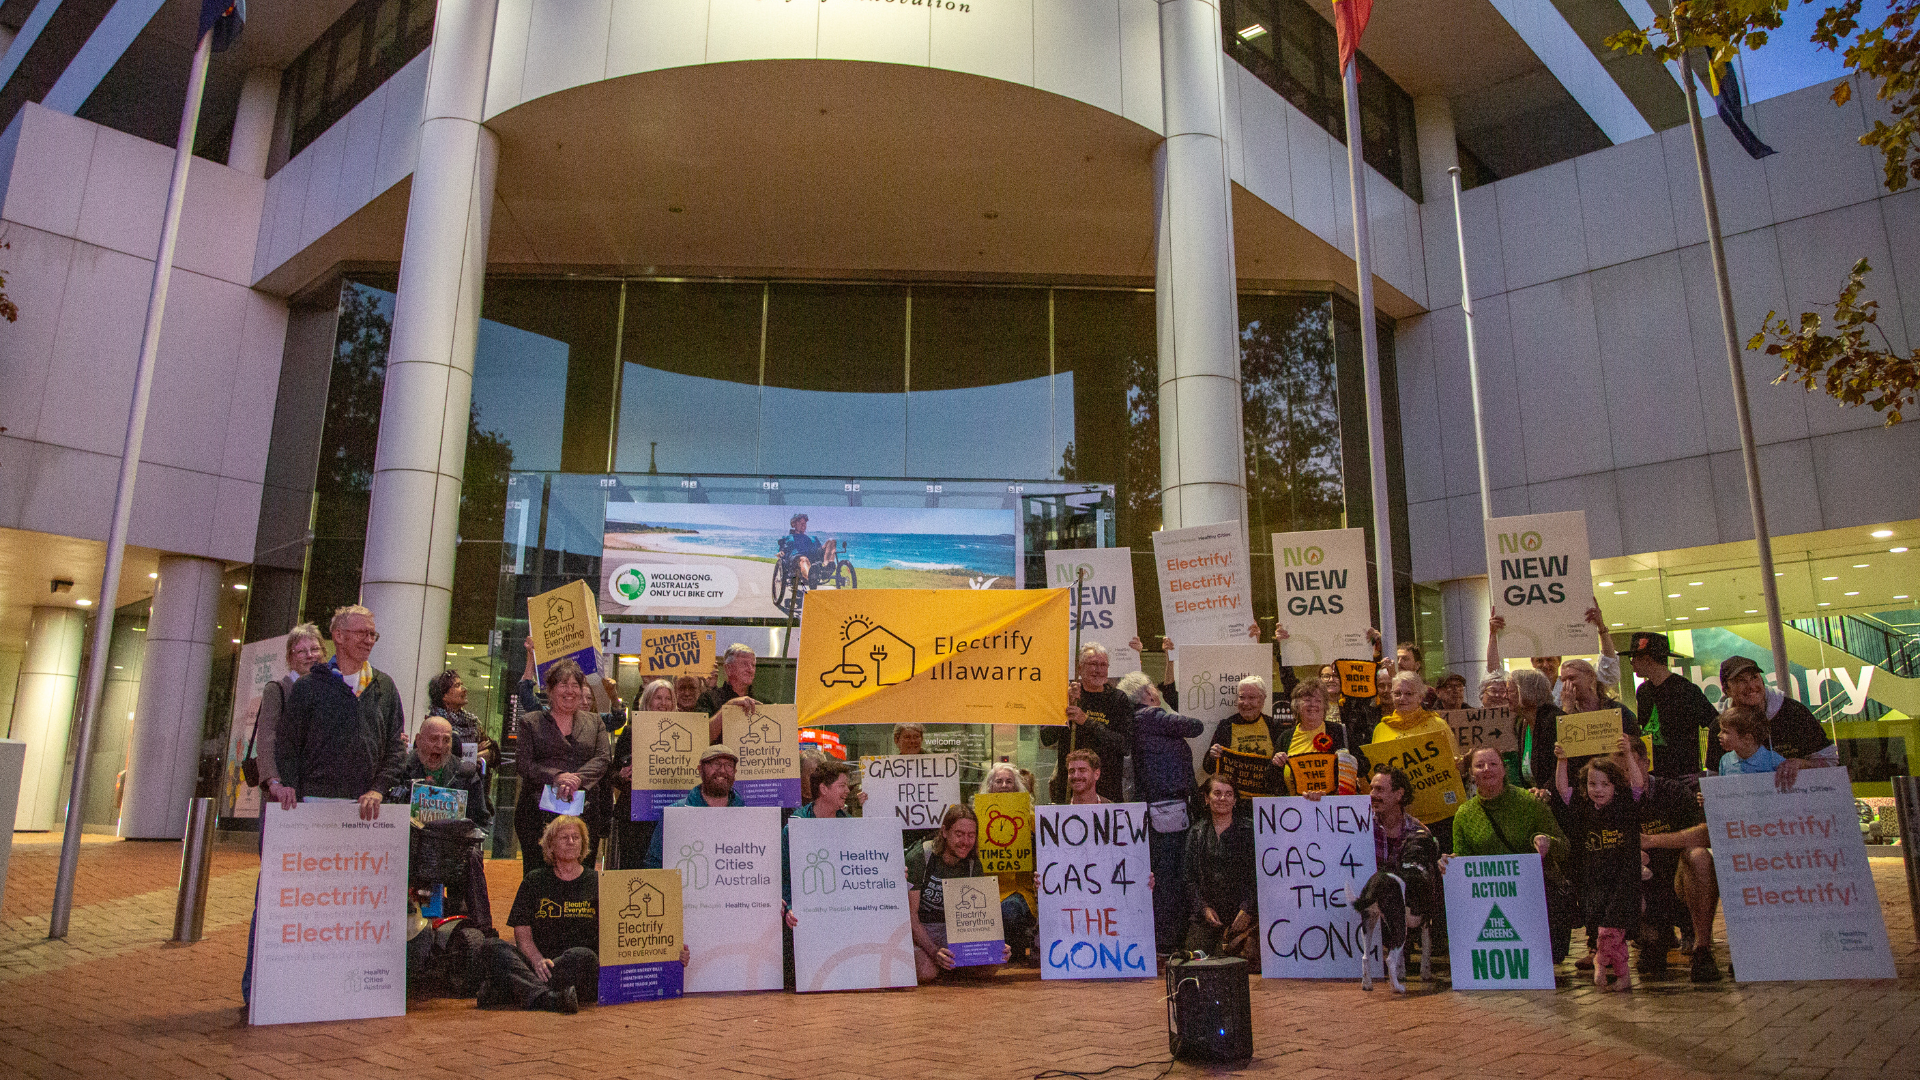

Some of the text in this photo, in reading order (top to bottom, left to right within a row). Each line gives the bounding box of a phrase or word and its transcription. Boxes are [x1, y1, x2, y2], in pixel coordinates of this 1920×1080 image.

[1498, 531, 1542, 554] NO
[1167, 551, 1232, 571] Electrify!
[1283, 546, 1324, 567] NO
[1056, 563, 1094, 583] NO
[1501, 555, 1568, 580] NEW
[1170, 572, 1235, 592] Electrify!
[1285, 569, 1347, 592] NEW
[1175, 593, 1241, 613] Electrify!
[1504, 583, 1565, 606] GAS
[1288, 594, 1344, 616] GAS
[544, 623, 575, 640] Electrify
[545, 630, 584, 649] Everything
[600, 628, 621, 647] 41
[646, 632, 697, 648] CLIMATE
[655, 640, 700, 655] ACTION
[935, 630, 1033, 655] Electrify
[649, 649, 700, 671] NOW
[930, 662, 1042, 682] Illawarra
[1346, 674, 1370, 682] MORE
[1219, 686, 1238, 694] Citi
[1351, 684, 1368, 692] GAS
[1466, 709, 1510, 722] WITH
[1587, 722, 1612, 730] Electrify
[1587, 728, 1618, 736] Everything
[924, 738, 960, 746] welcome
[740, 746, 780, 757] Electrify
[649, 755, 691, 766] Electrify
[740, 756, 791, 768] Everything
[869, 757, 958, 778] GASFIELD
[1298, 760, 1328, 769] STOP
[1425, 764, 1435, 773] &
[649, 766, 700, 778] Everything
[1304, 770, 1326, 778] THE
[898, 783, 939, 802] FREE
[1307, 782, 1327, 791] GAS
[418, 793, 456, 810] PROTECT
[895, 804, 947, 826] NSW
[1259, 804, 1372, 834] NO NEW
[1040, 809, 1149, 847] NO NEW
[1726, 815, 1838, 840] Electrify!
[715, 842, 766, 856] Healthy
[840, 850, 890, 864] Healthy
[1016, 849, 1030, 859] UP
[282, 852, 389, 874] Electrify!
[715, 858, 754, 870] Cities
[986, 861, 1021, 872] 4 GAS
[1262, 842, 1364, 878] GAS 4
[1732, 850, 1846, 872] Electrify!
[840, 864, 878, 876] Cities
[1042, 858, 1135, 896] GAS 4
[1464, 860, 1520, 878] CLIMATE
[715, 874, 770, 886] Australia
[842, 878, 896, 890] Australia
[280, 886, 388, 910] Electrify!
[1290, 885, 1348, 910] THE
[1472, 881, 1518, 898] ACTION
[1742, 882, 1858, 906] Electrify!
[564, 906, 596, 914] Everything
[956, 910, 987, 918] Electrify
[618, 921, 664, 934] Electrify
[956, 918, 994, 927] Everything
[1061, 908, 1120, 936] THE
[1490, 918, 1505, 928] THE
[282, 920, 390, 944] Electrify!
[1482, 929, 1514, 938] GREENS
[618, 934, 674, 948] Everything
[618, 948, 667, 958] FOR EVERYONE
[1048, 940, 1146, 972] GONG
[364, 968, 390, 976] Healthy
[1471, 948, 1529, 980] NOW
